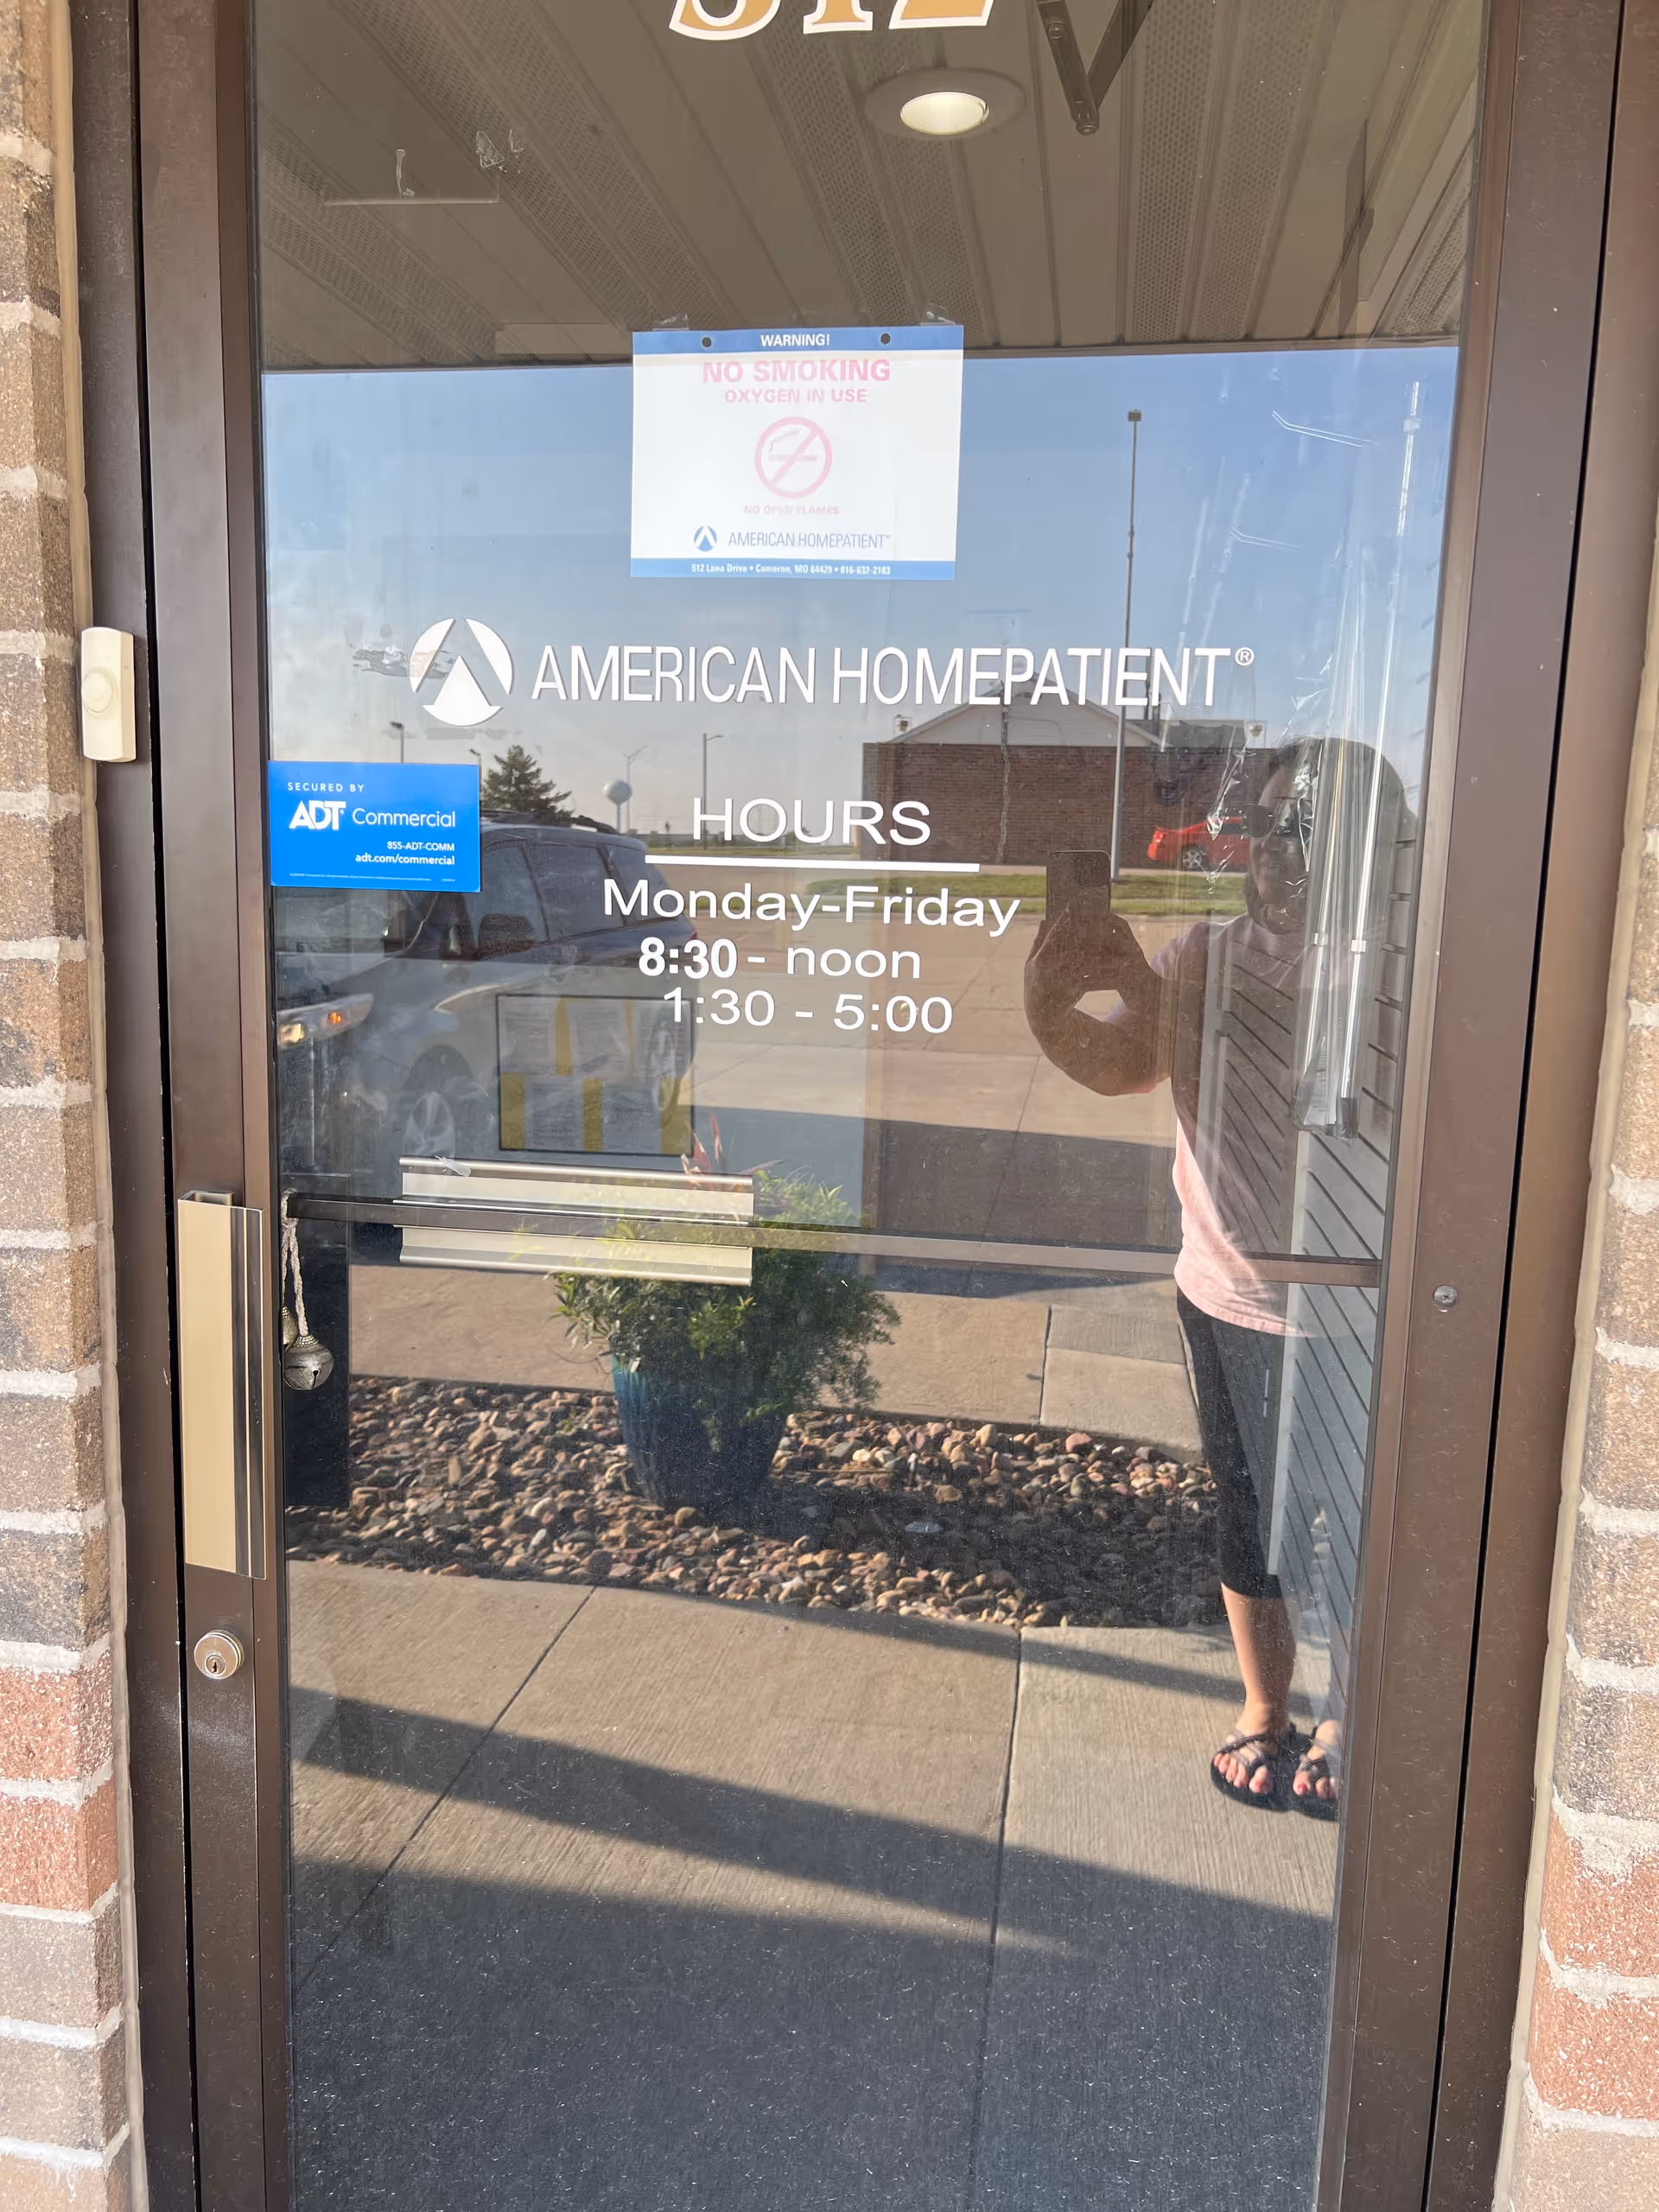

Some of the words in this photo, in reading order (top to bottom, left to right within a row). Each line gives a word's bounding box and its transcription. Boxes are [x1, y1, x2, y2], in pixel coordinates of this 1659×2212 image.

[760, 334, 830, 346] WARNING!
[702, 361, 743, 383] NO
[753, 359, 891, 382] SMOKING
[724, 389, 800, 404] OXYGEN
[807, 389, 824, 403] IN
[831, 388, 868, 403] USE
[744, 505, 760, 515] NO
[764, 505, 793, 515] OPEN
[796, 505, 840, 515] FLAMES
[728, 532, 795, 547] AMERICAN
[691, 563, 705, 573] 512
[727, 563, 747, 573] Drive
[755, 563, 792, 575] Cameron,
[795, 564, 810, 574] MO
[531, 645, 816, 704] AMERICAN
[288, 782, 343, 792] SECURED
[350, 784, 365, 792] BY
[352, 808, 456, 827] Commercial
[691, 798, 931, 846] HOURS
[387, 841, 455, 851] 855-ADT-COMM
[355, 852, 455, 865] adt.com/commercial
[603, 878, 1021, 938] Monday-Friday
[638, 937, 738, 979] 8:30
[786, 946, 920, 979] noon
[663, 986, 775, 1027] 1:30
[832, 993, 953, 1034] 5:00
